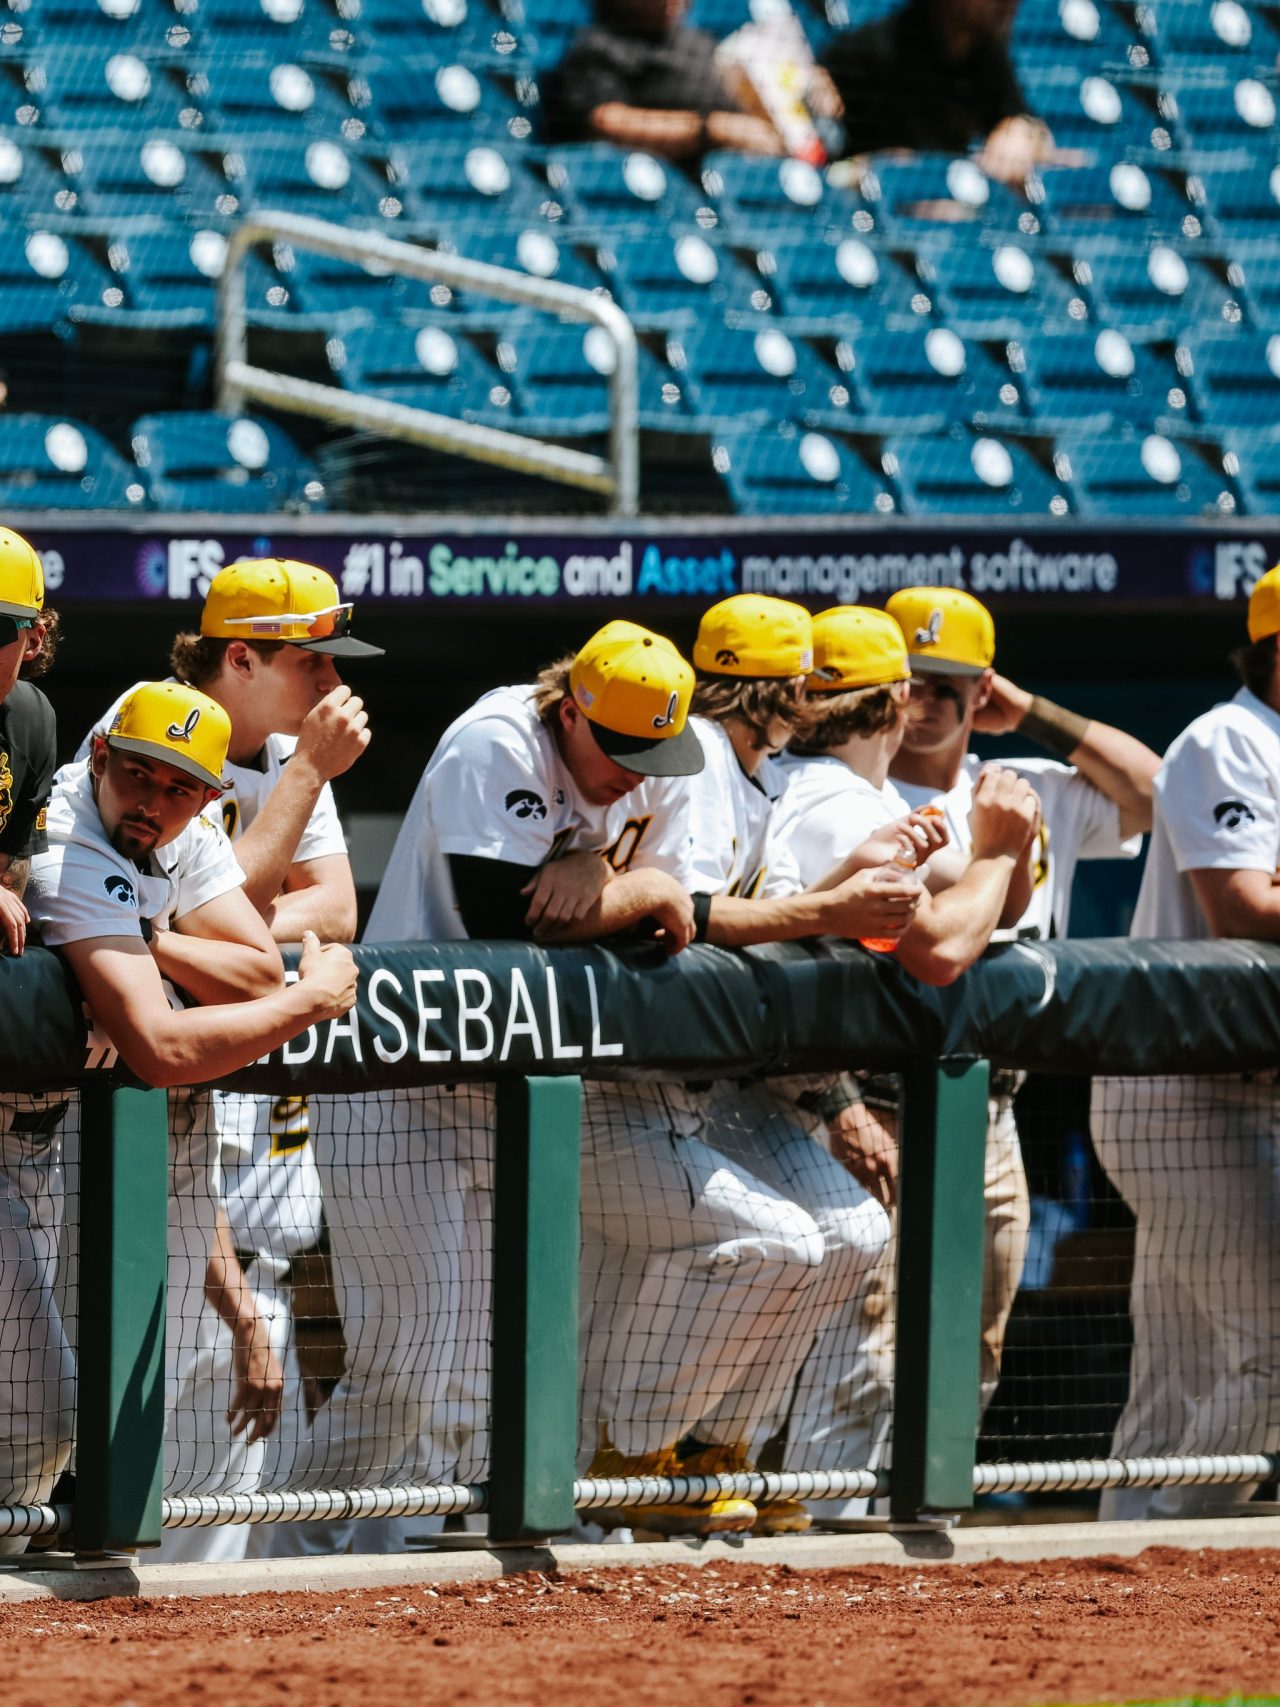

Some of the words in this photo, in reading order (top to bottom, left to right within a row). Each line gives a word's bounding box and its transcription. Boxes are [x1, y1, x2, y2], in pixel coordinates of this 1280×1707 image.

[341, 543, 385, 596] #1
[389, 541, 424, 597] in
[428, 541, 560, 597] Service
[563, 540, 633, 597] and
[637, 543, 737, 595] Asset
[742, 544, 965, 604] management
[970, 538, 1118, 592] software
